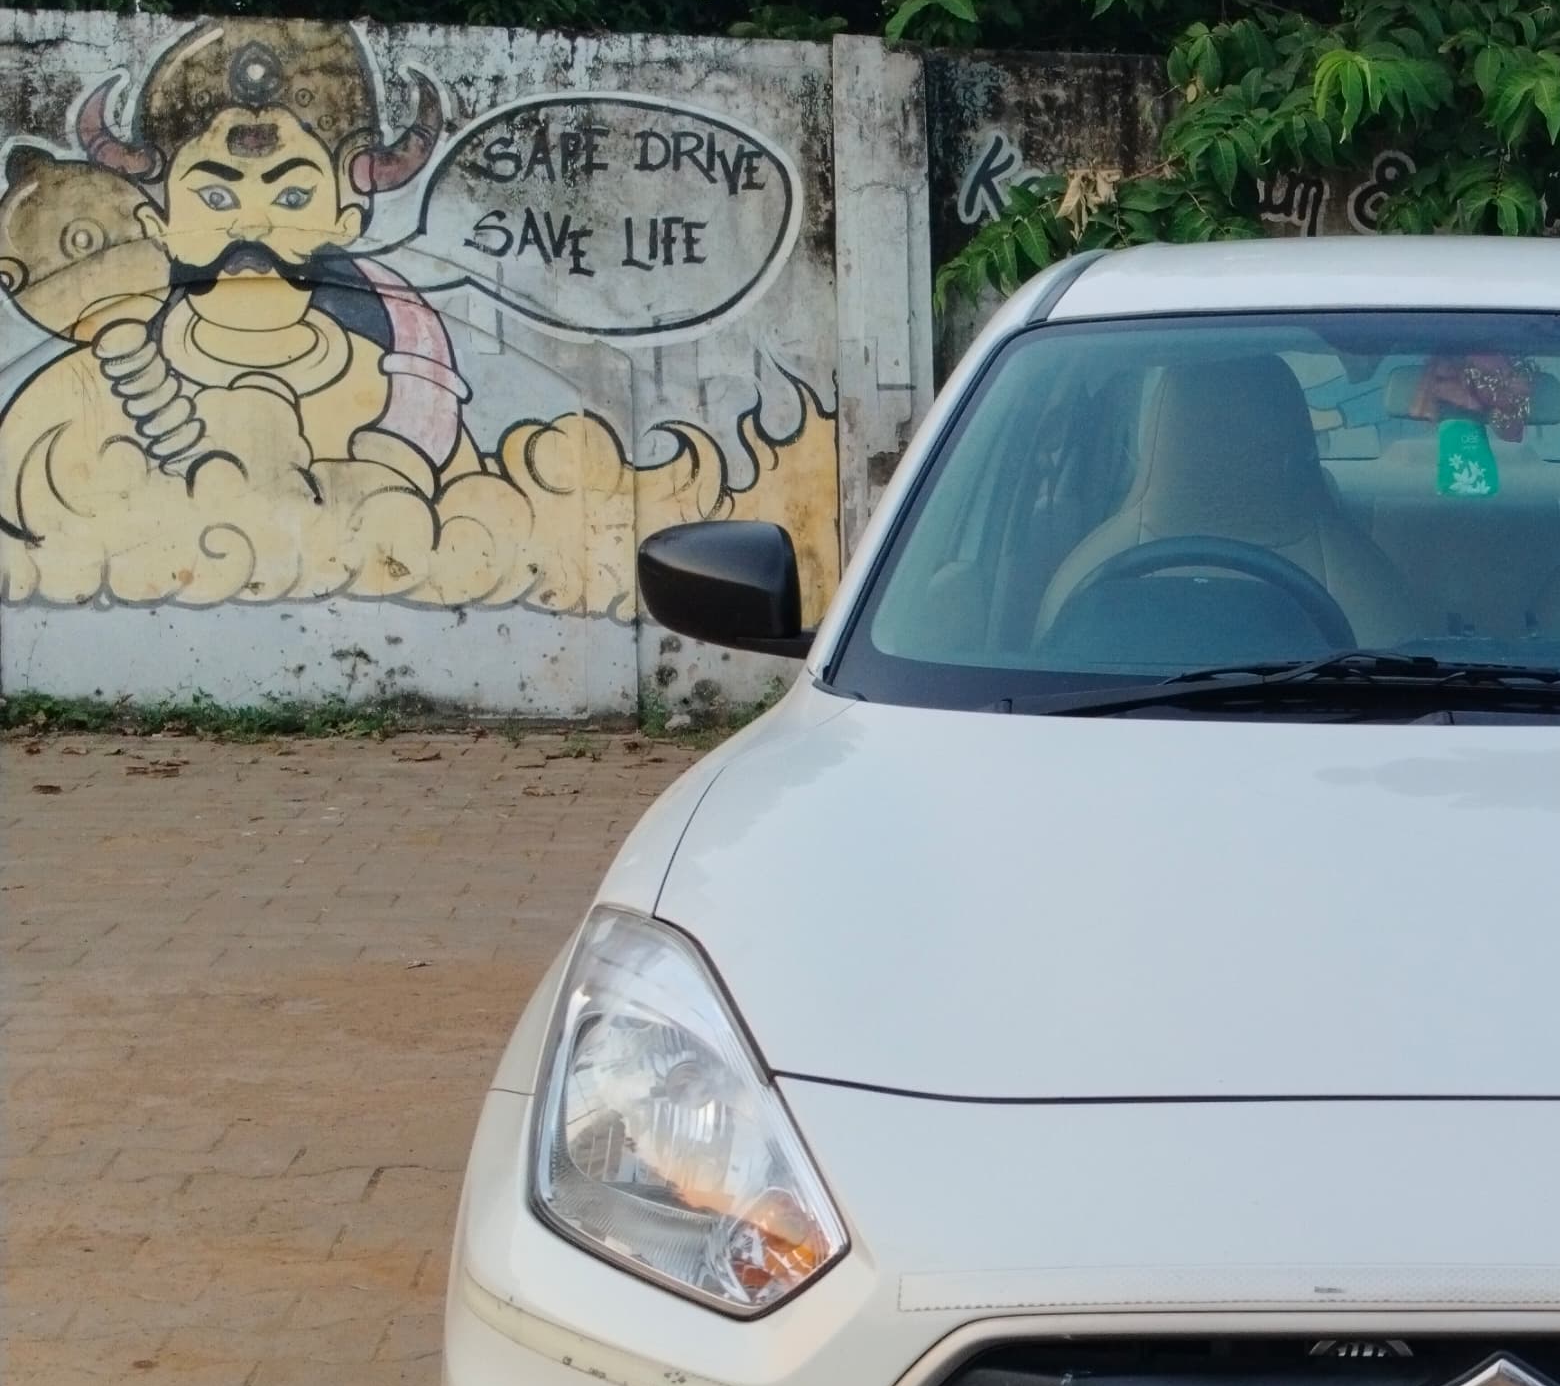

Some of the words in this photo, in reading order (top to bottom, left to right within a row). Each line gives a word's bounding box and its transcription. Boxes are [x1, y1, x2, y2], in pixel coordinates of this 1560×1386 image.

[634, 128, 766, 196] DRIVE
[463, 208, 596, 277] SAVE
[621, 216, 708, 271] LIFE
